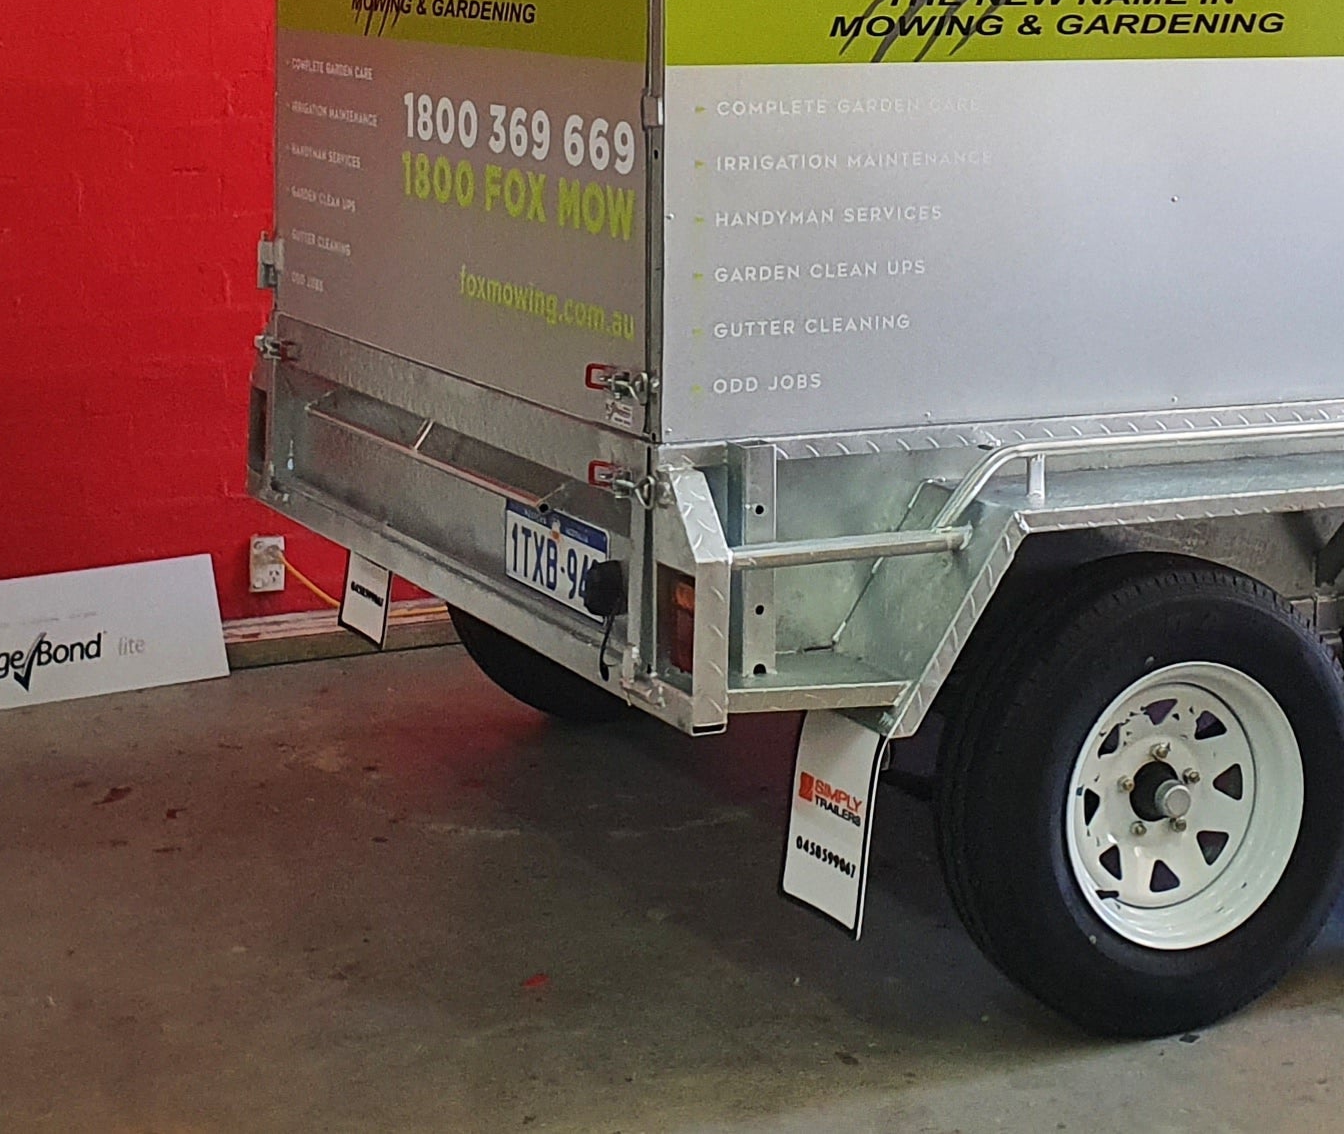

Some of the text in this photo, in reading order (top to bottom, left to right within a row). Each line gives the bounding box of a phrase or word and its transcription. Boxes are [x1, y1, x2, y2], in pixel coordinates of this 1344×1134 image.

[830, 12, 1285, 37] MOWING & GARDENING
[716, 99, 827, 117] COMPLETE
[837, 97, 920, 113] GARDEN
[403, 92, 635, 175] 1800 369 669
[716, 154, 838, 171] IRRIGATION
[402, 151, 635, 241] 1800 FOX MOW
[715, 206, 943, 227] HANDYMAN SERVICES
[714, 260, 926, 283] GARDEN CLEAN UPS
[460, 263, 635, 340] foxmowing.com.au
[713, 315, 911, 338] GUTTER CLEANING
[713, 373, 823, 394] ODD JOBS
[118, 637, 145, 656] lite
[815, 779, 862, 813] SIMPLY
[815, 795, 861, 827] TRAILERS
